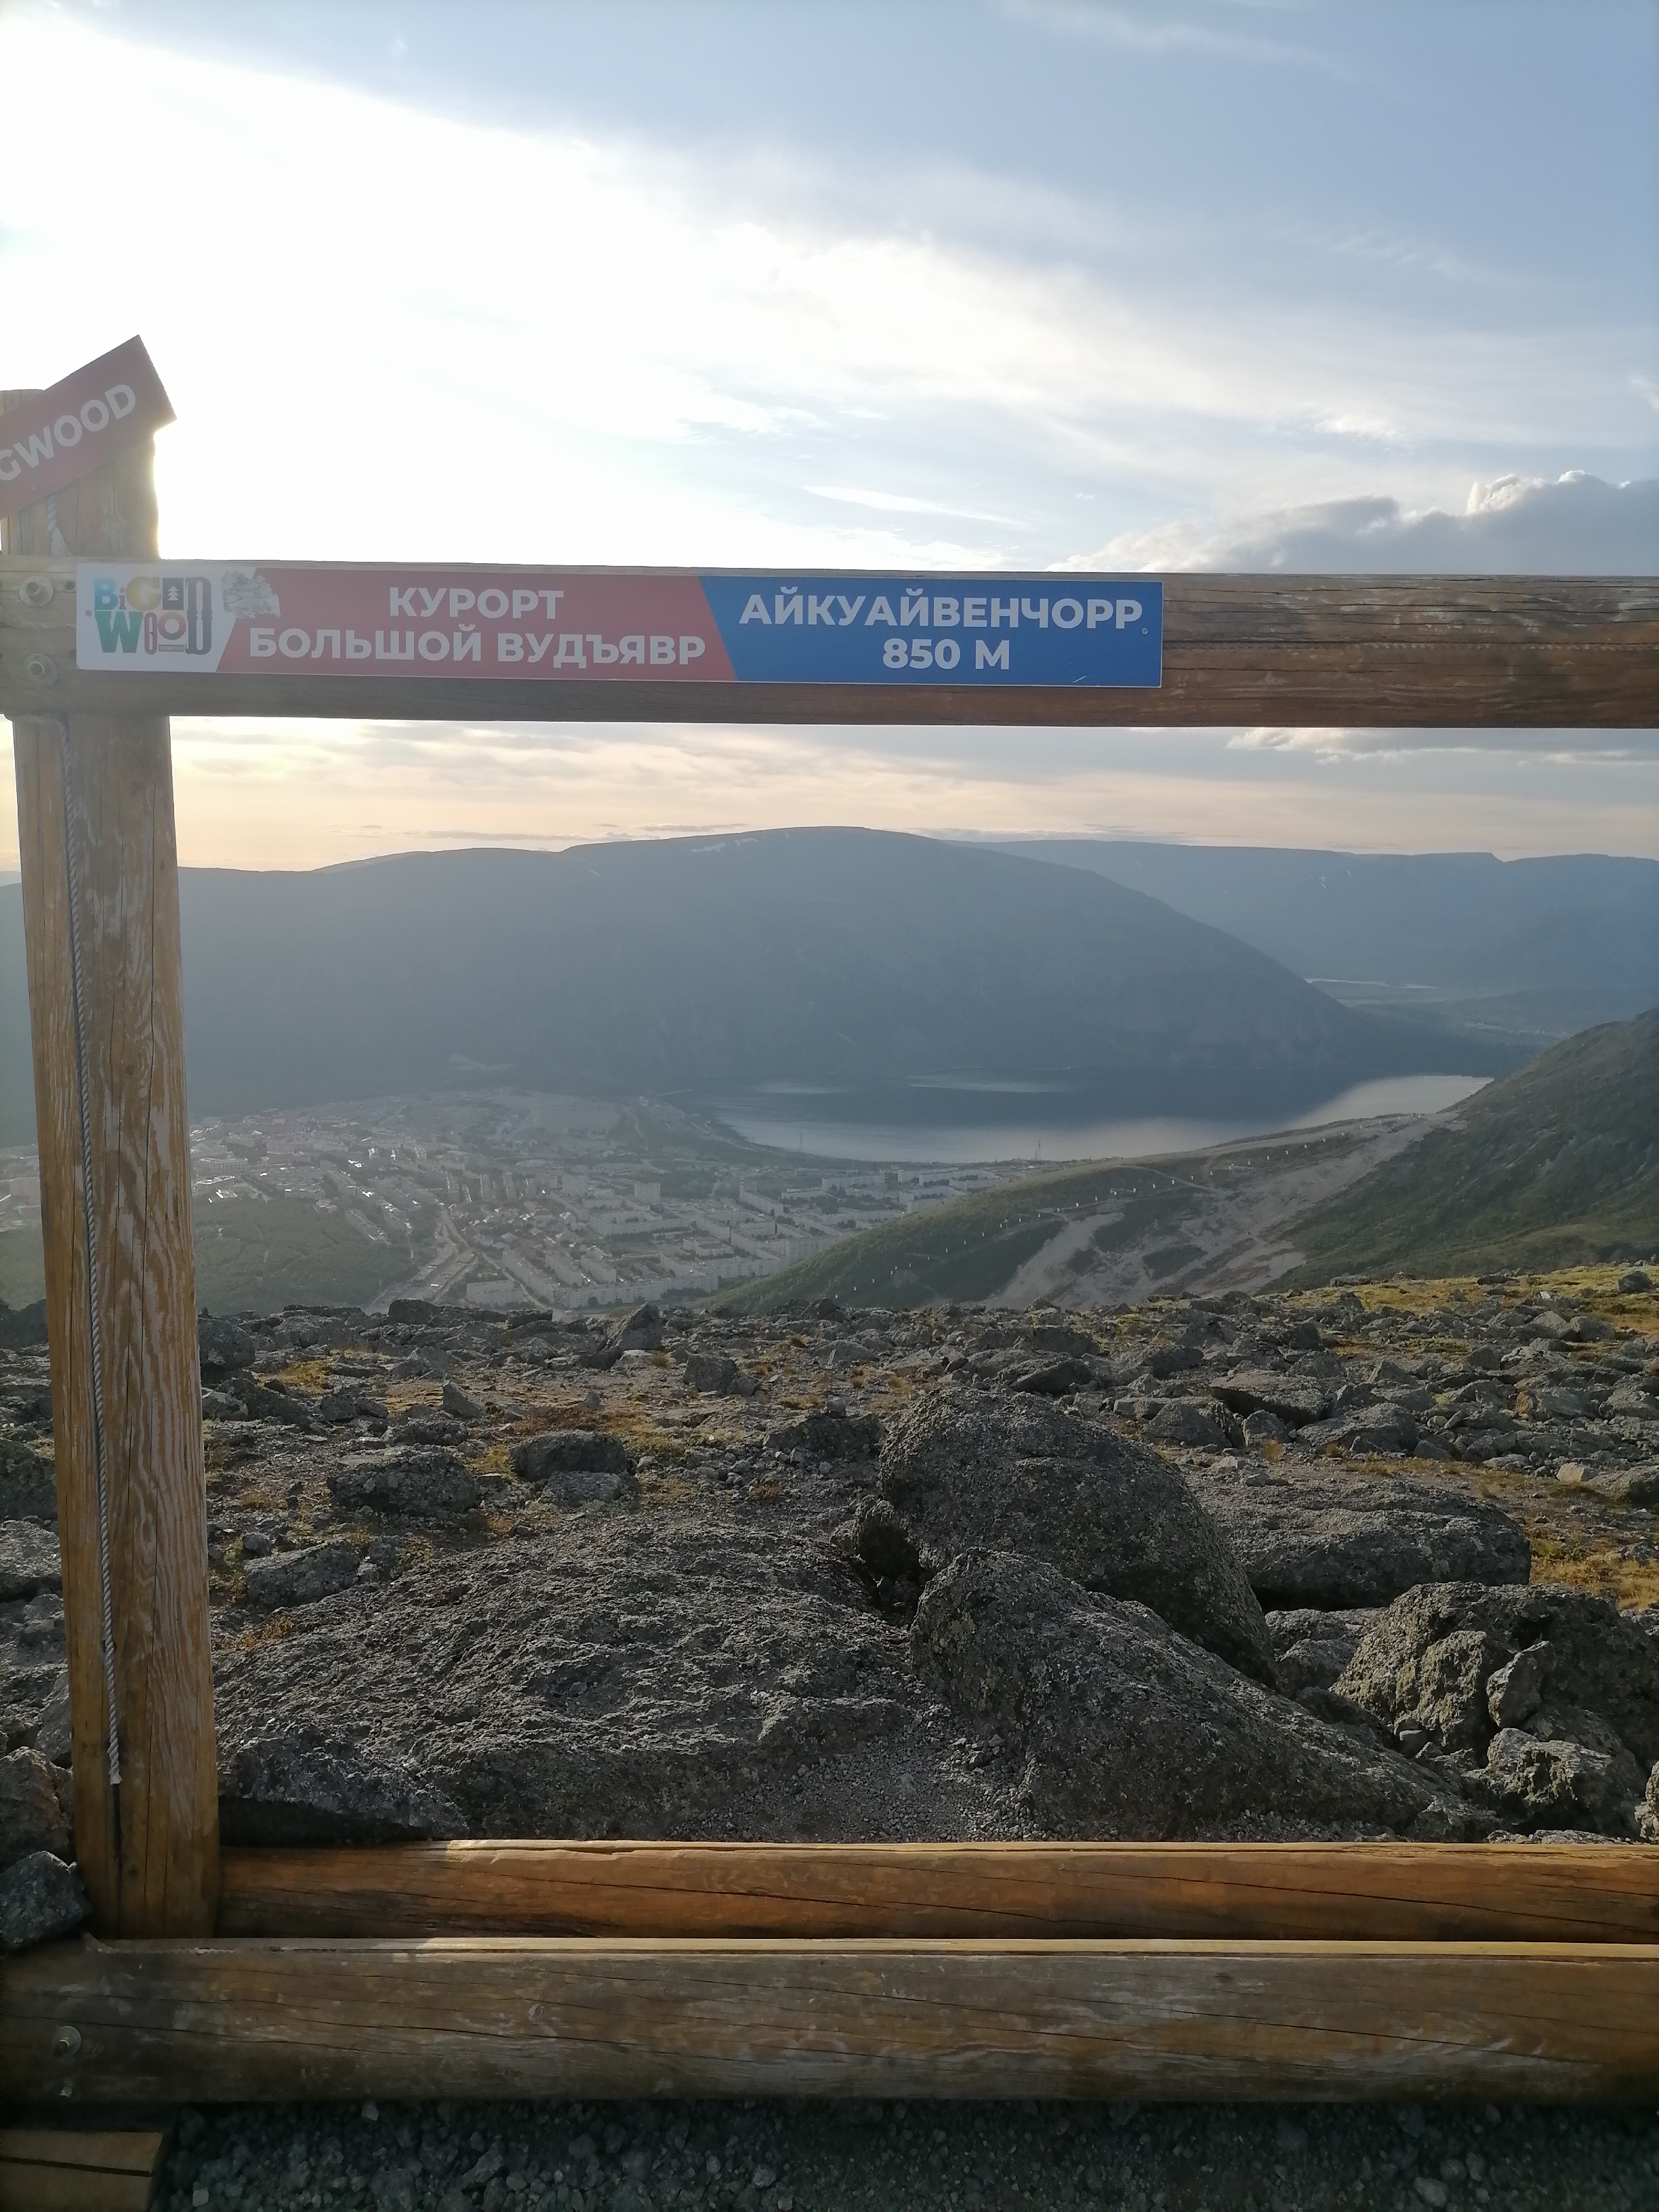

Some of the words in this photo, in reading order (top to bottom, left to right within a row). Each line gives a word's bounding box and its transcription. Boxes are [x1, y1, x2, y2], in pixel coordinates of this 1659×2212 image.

[390, 587, 564, 619] КУРОРТ
[739, 587, 1143, 629] АЙКУАЙВЕНЧОРР
[249, 624, 481, 662] БОЛЬШОЙ
[497, 632, 705, 669] ВУДЪЯВР
[882, 638, 960, 670] 850
[976, 640, 1010, 670] М
